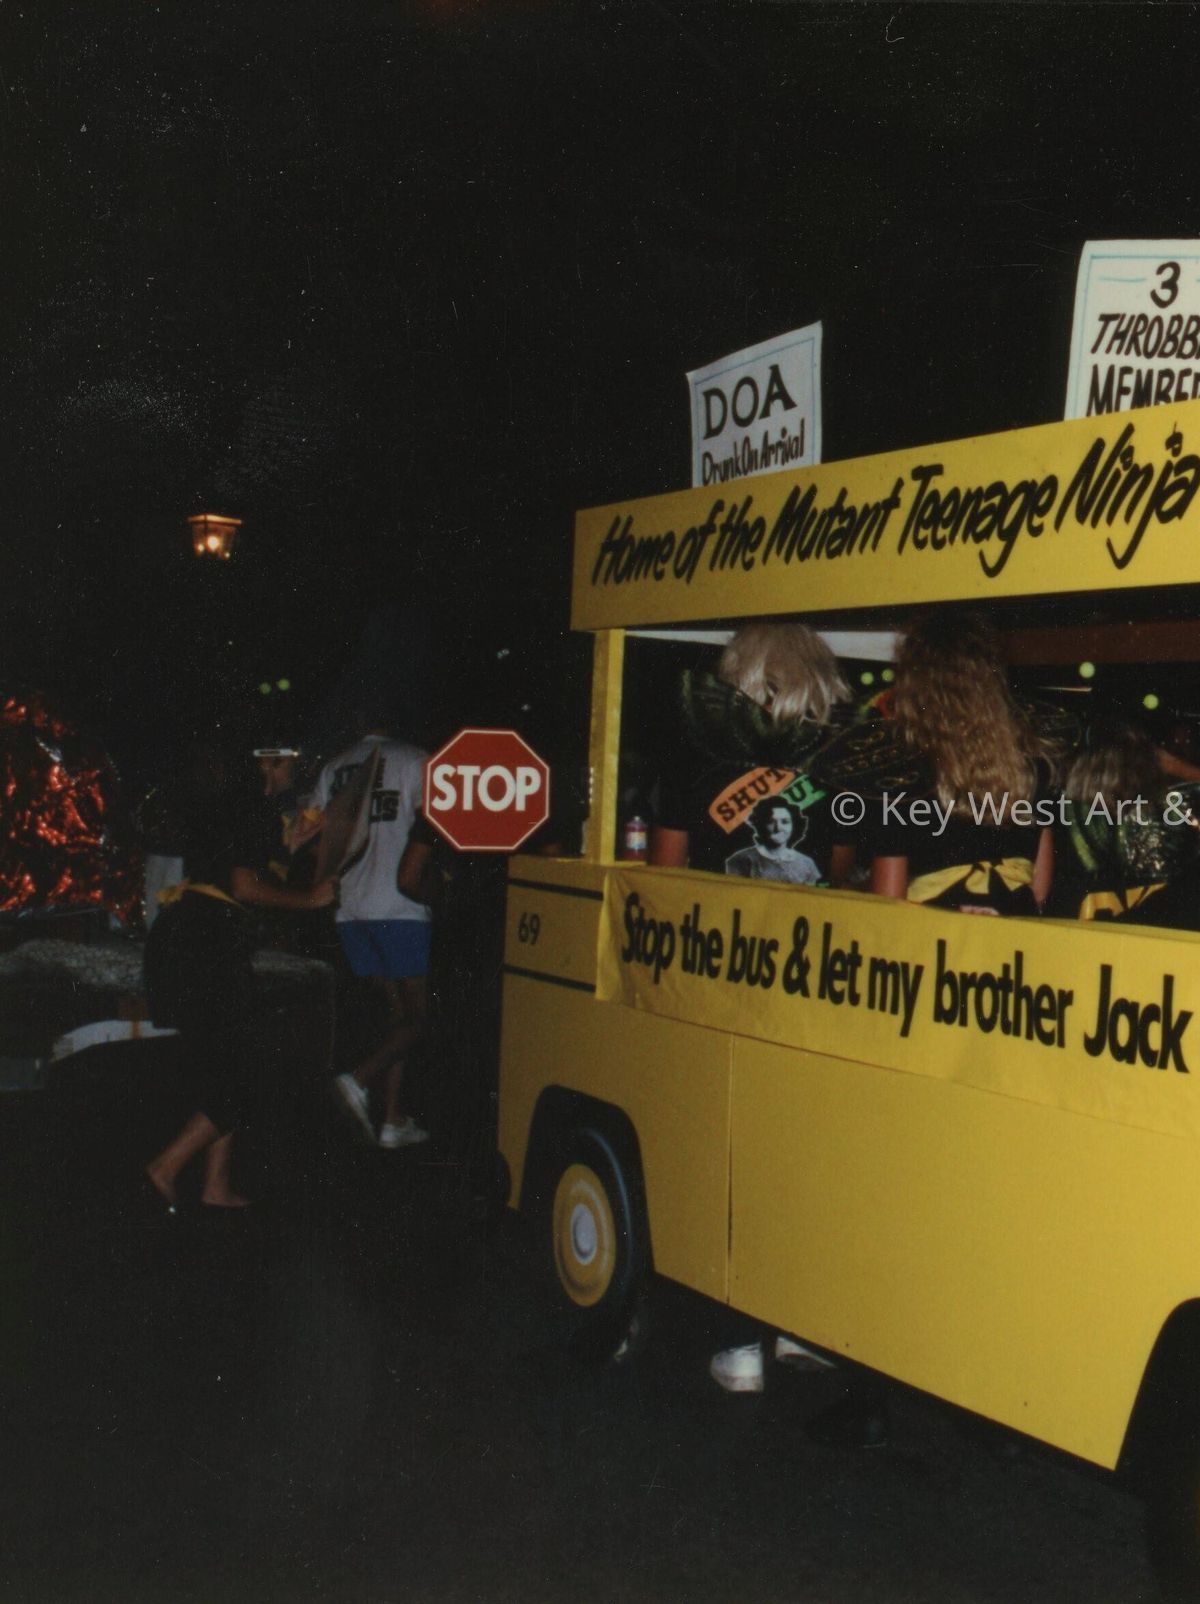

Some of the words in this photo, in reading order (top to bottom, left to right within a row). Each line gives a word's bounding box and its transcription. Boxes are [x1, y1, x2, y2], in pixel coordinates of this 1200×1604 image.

[1150, 260, 1181, 309] 3
[702, 363, 798, 440] DOA
[702, 441, 743, 487] Drunk
[742, 435, 758, 476] On
[760, 418, 805, 470] Arrival
[591, 515, 676, 586] Home
[673, 499, 726, 585] of
[708, 495, 767, 573] the
[762, 475, 905, 566] Mutant
[897, 463, 1058, 579] Teenage
[431, 763, 542, 812] STOP
[517, 911, 541, 946] 69
[621, 891, 677, 985] Stop
[680, 903, 724, 979] the
[726, 908, 779, 990] bus
[782, 915, 812, 999] &
[817, 921, 863, 1007] let
[867, 955, 925, 1038] my
[933, 938, 1075, 1049] brother
[1083, 963, 1195, 1075] Jack
